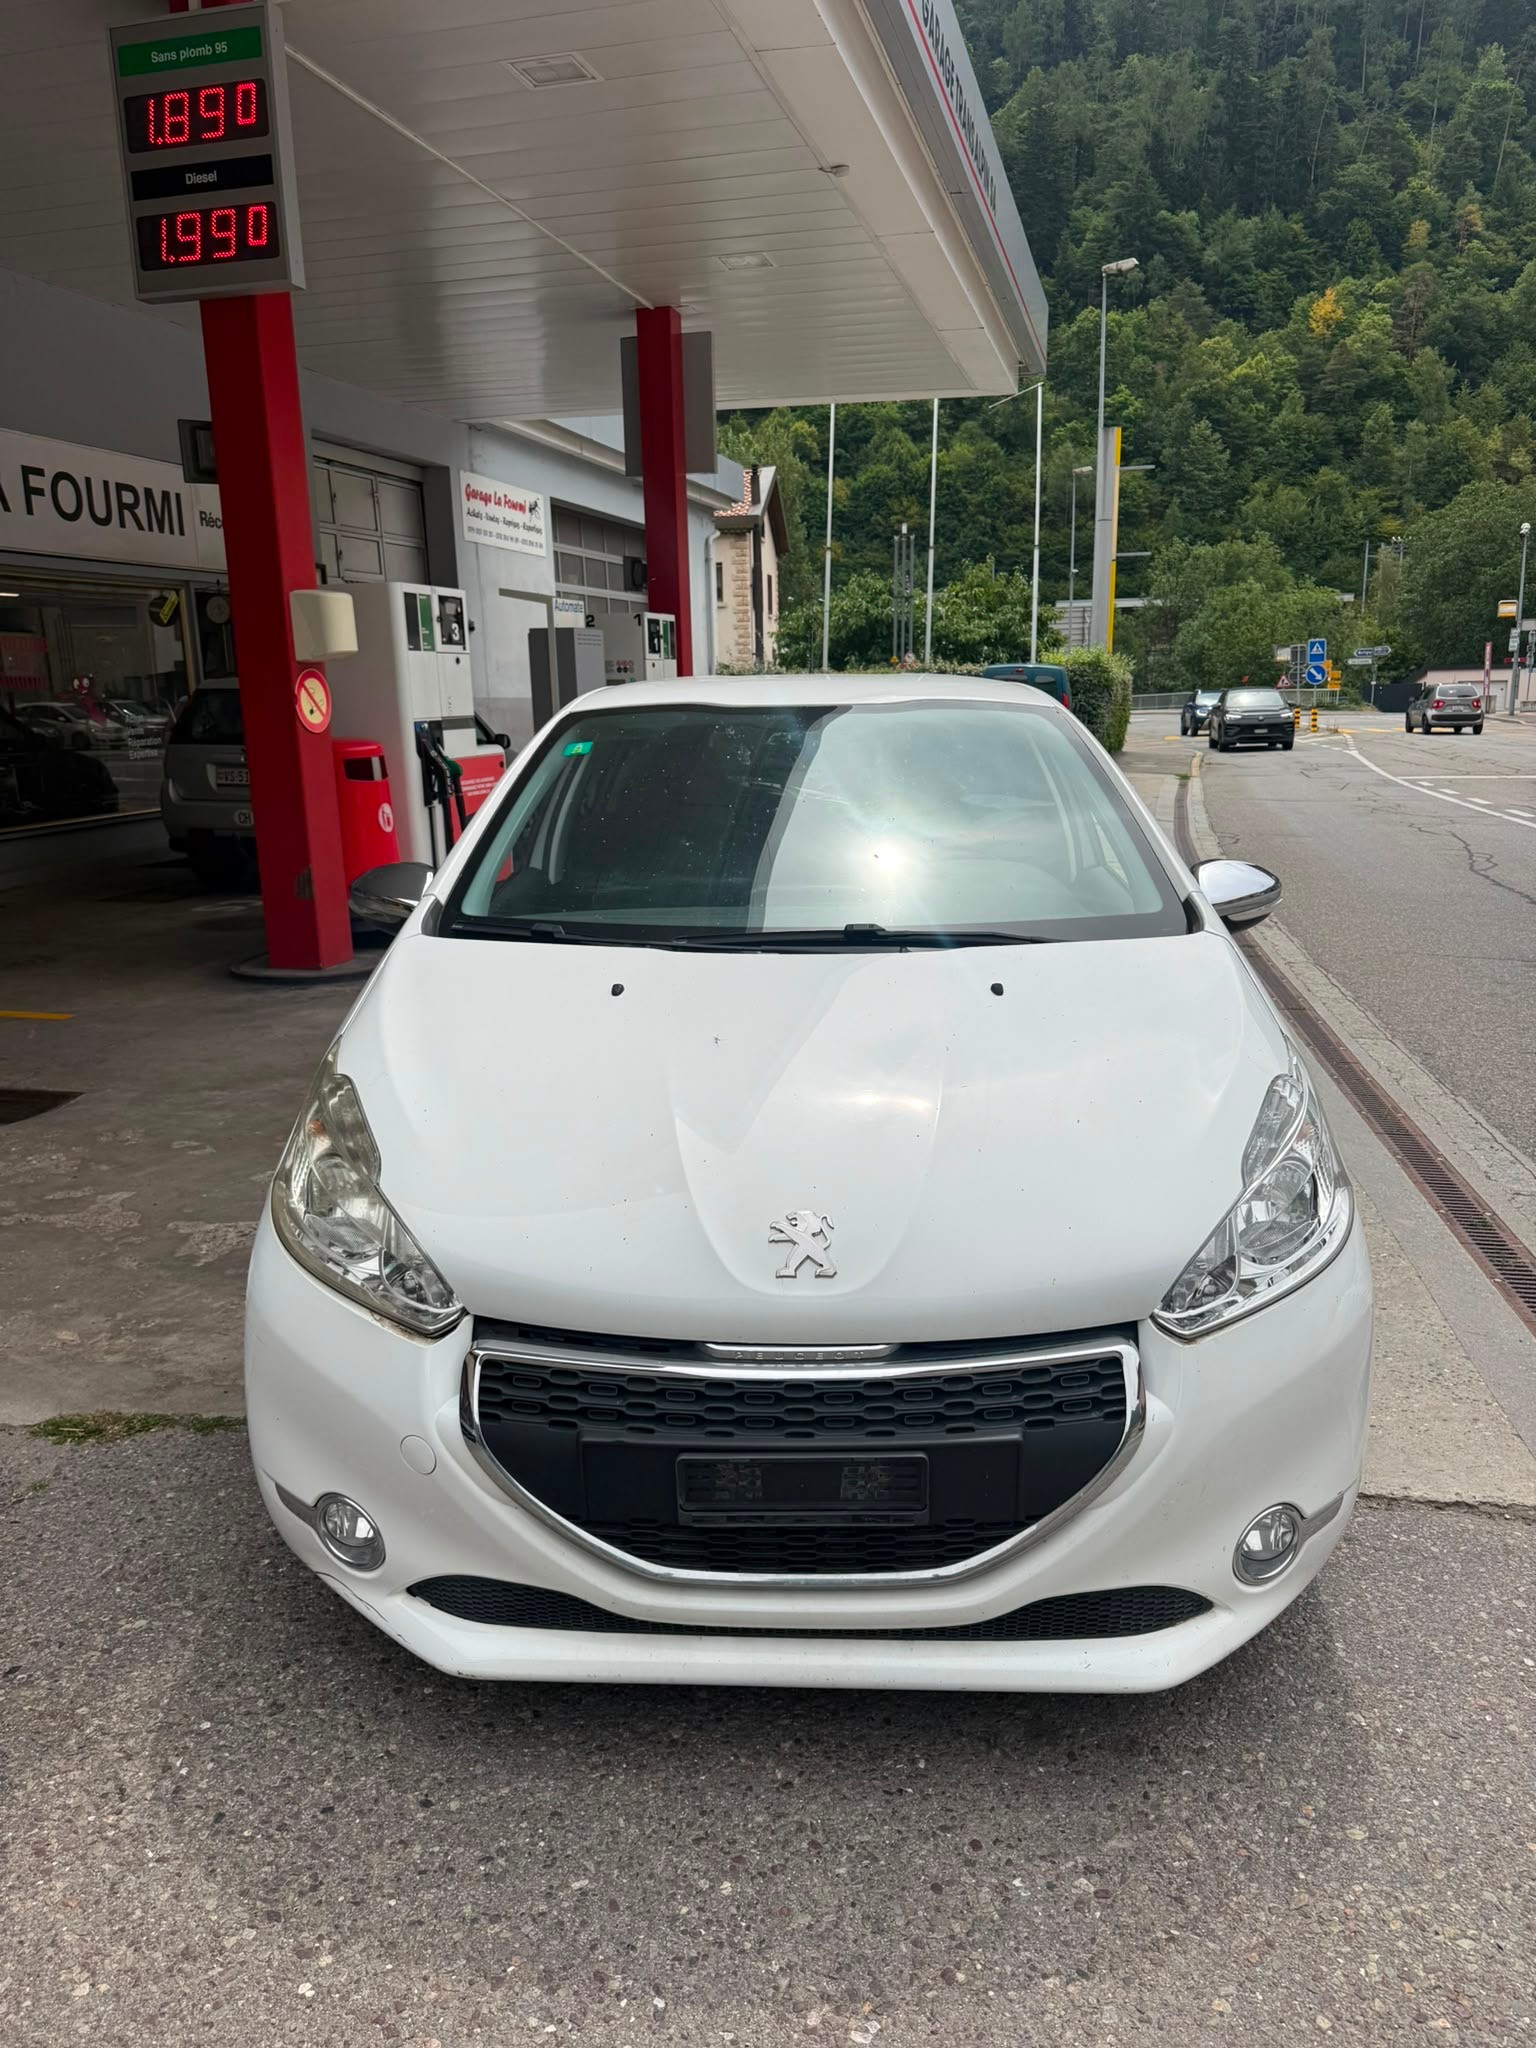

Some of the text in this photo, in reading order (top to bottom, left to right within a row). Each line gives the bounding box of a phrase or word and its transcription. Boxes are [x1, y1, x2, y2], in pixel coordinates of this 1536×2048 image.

[151, 41, 228, 64] Sans plomb 95
[921, 0, 955, 101] GARAGE
[148, 82, 257, 145] 1.890
[185, 170, 218, 186] Diesel
[160, 204, 268, 264] 1.990
[21, 464, 186, 537] FOURMI
[465, 483, 527, 514] Garage La Fourmi
[451, 622, 460, 641] 3
[586, 614, 595, 627] 2
[633, 613, 642, 627] 1
